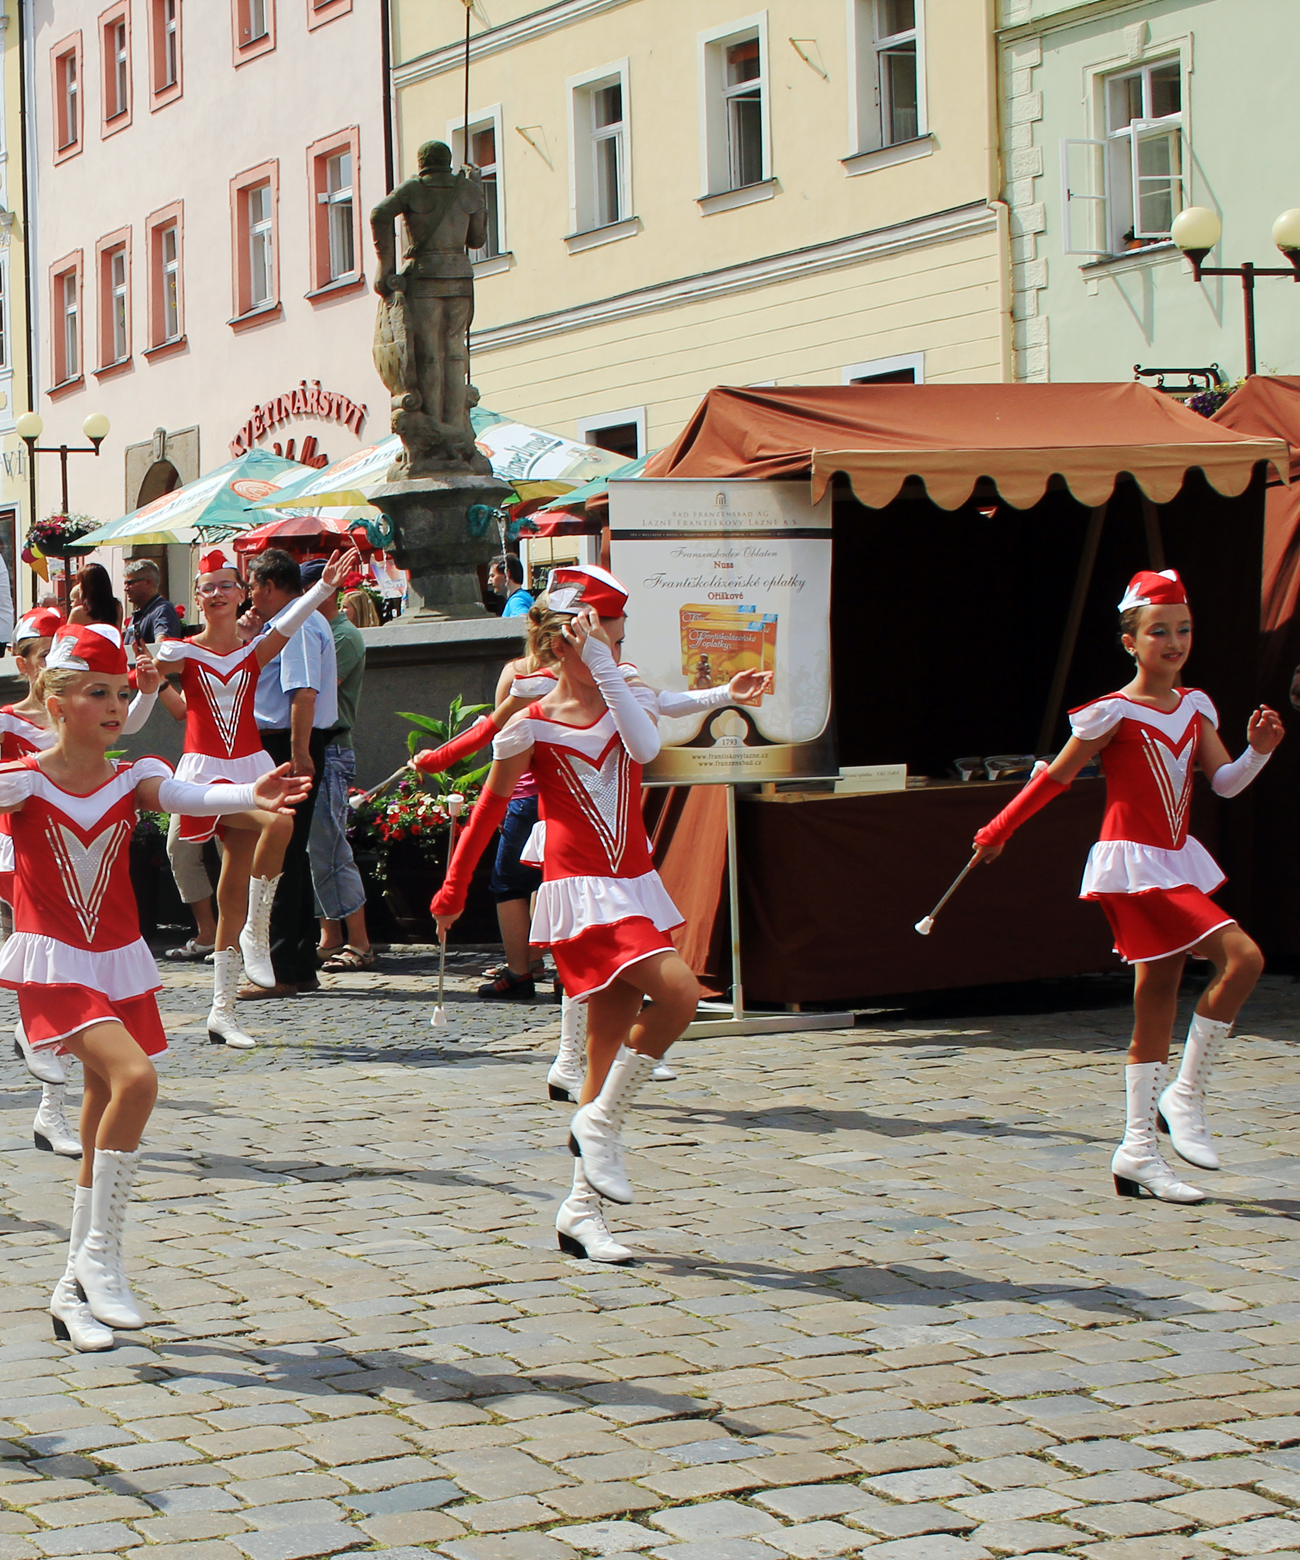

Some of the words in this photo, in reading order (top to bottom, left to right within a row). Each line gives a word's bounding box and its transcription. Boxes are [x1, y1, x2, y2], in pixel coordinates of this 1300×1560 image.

[228, 379, 368, 460] KVĚTINÁŘSTVÍ
[672, 510, 689, 518] BAD
[693, 510, 754, 518] FRANZENSBAD
[670, 547, 739, 558] Franzensbader
[713, 561, 734, 569] Nuss
[643, 573, 760, 589] Františkolázeňské
[763, 574, 807, 593] oplatky
